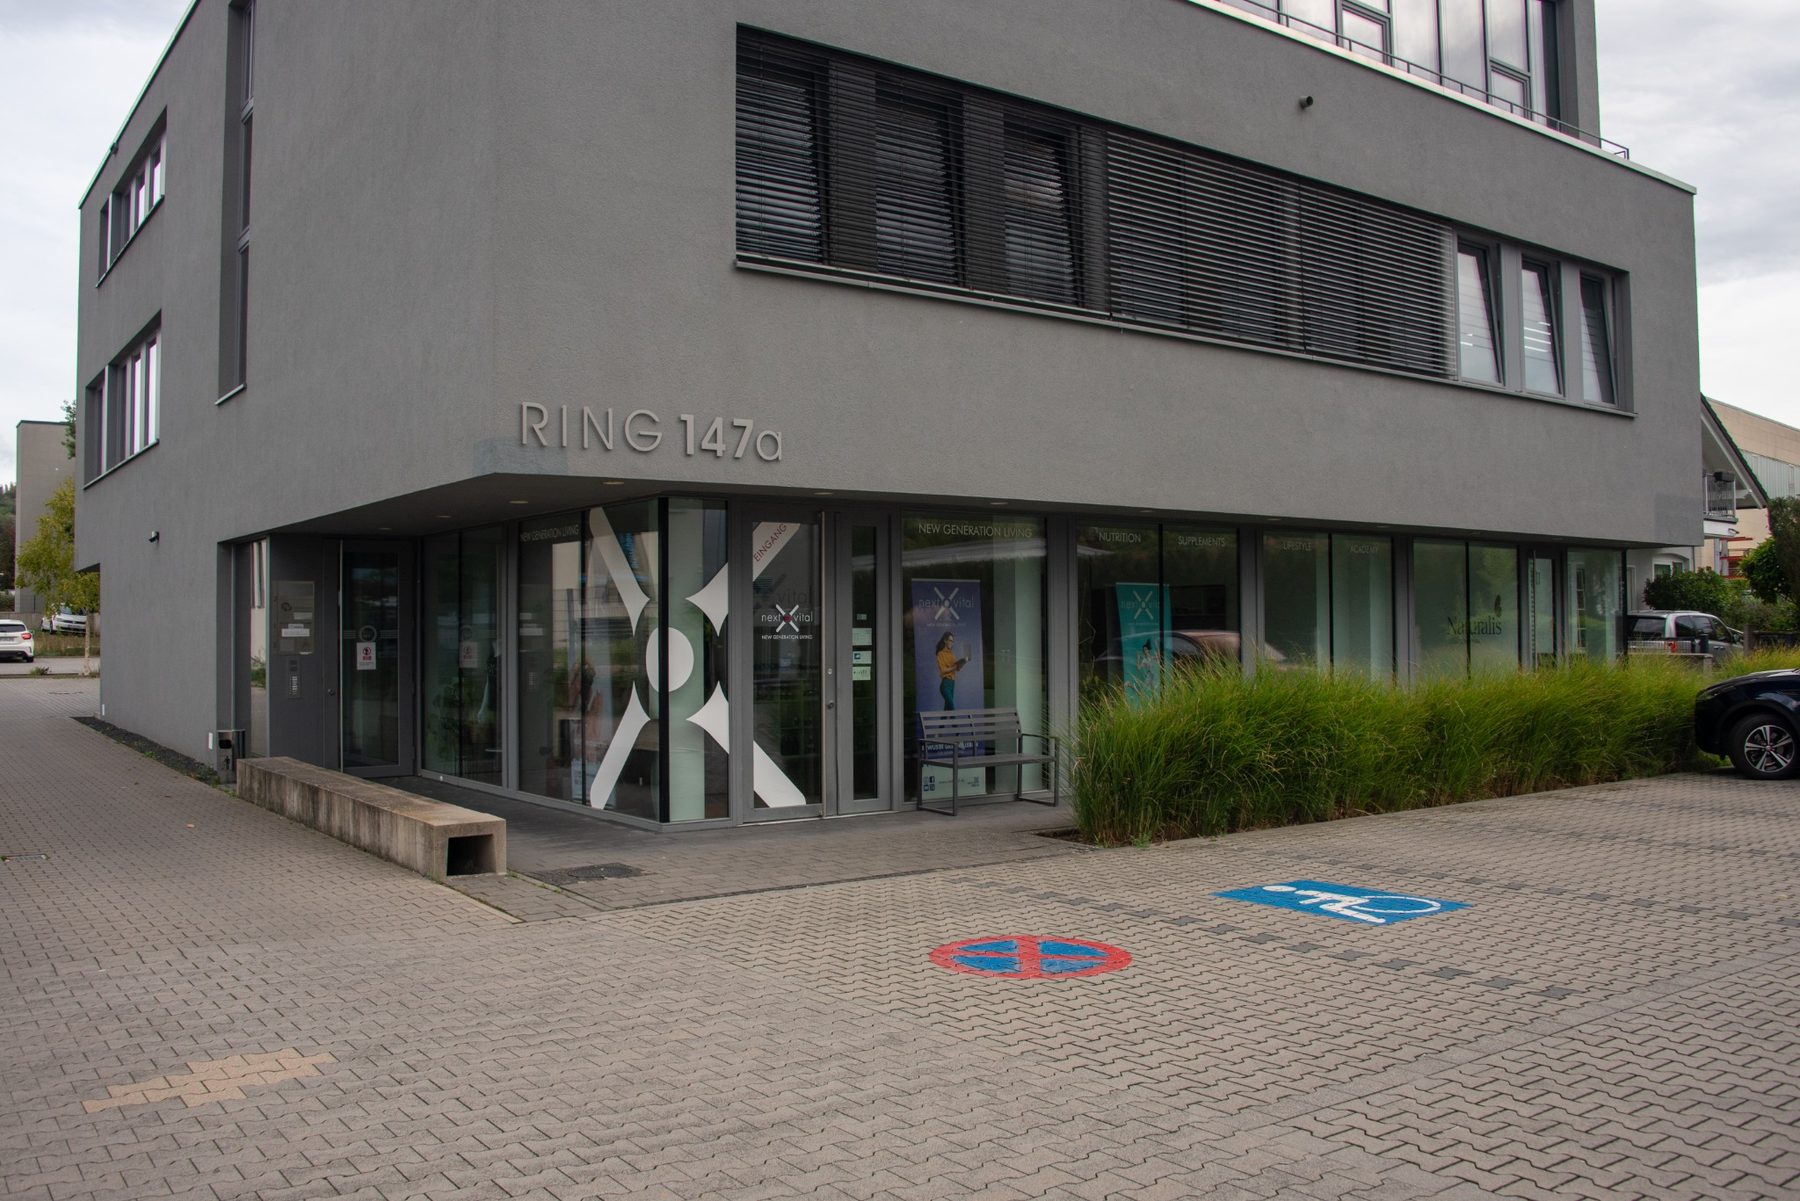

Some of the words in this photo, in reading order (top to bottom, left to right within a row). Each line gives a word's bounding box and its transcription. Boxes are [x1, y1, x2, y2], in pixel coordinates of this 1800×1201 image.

[520, 401, 663, 453] RING
[680, 413, 784, 462] 147a
[918, 523, 941, 534] NEW
[943, 524, 1001, 536] GENERATION
[1003, 527, 1033, 538] LIVING
[1098, 532, 1142, 543] NUTRITION
[753, 523, 787, 562] EINGANG
[1177, 535, 1226, 547] SUPPLEMENTS
[918, 598, 941, 608] next
[953, 595, 974, 609] vital
[761, 613, 781, 622] next
[794, 611, 814, 622] vital
[1447, 616, 1502, 636] Nauralis
